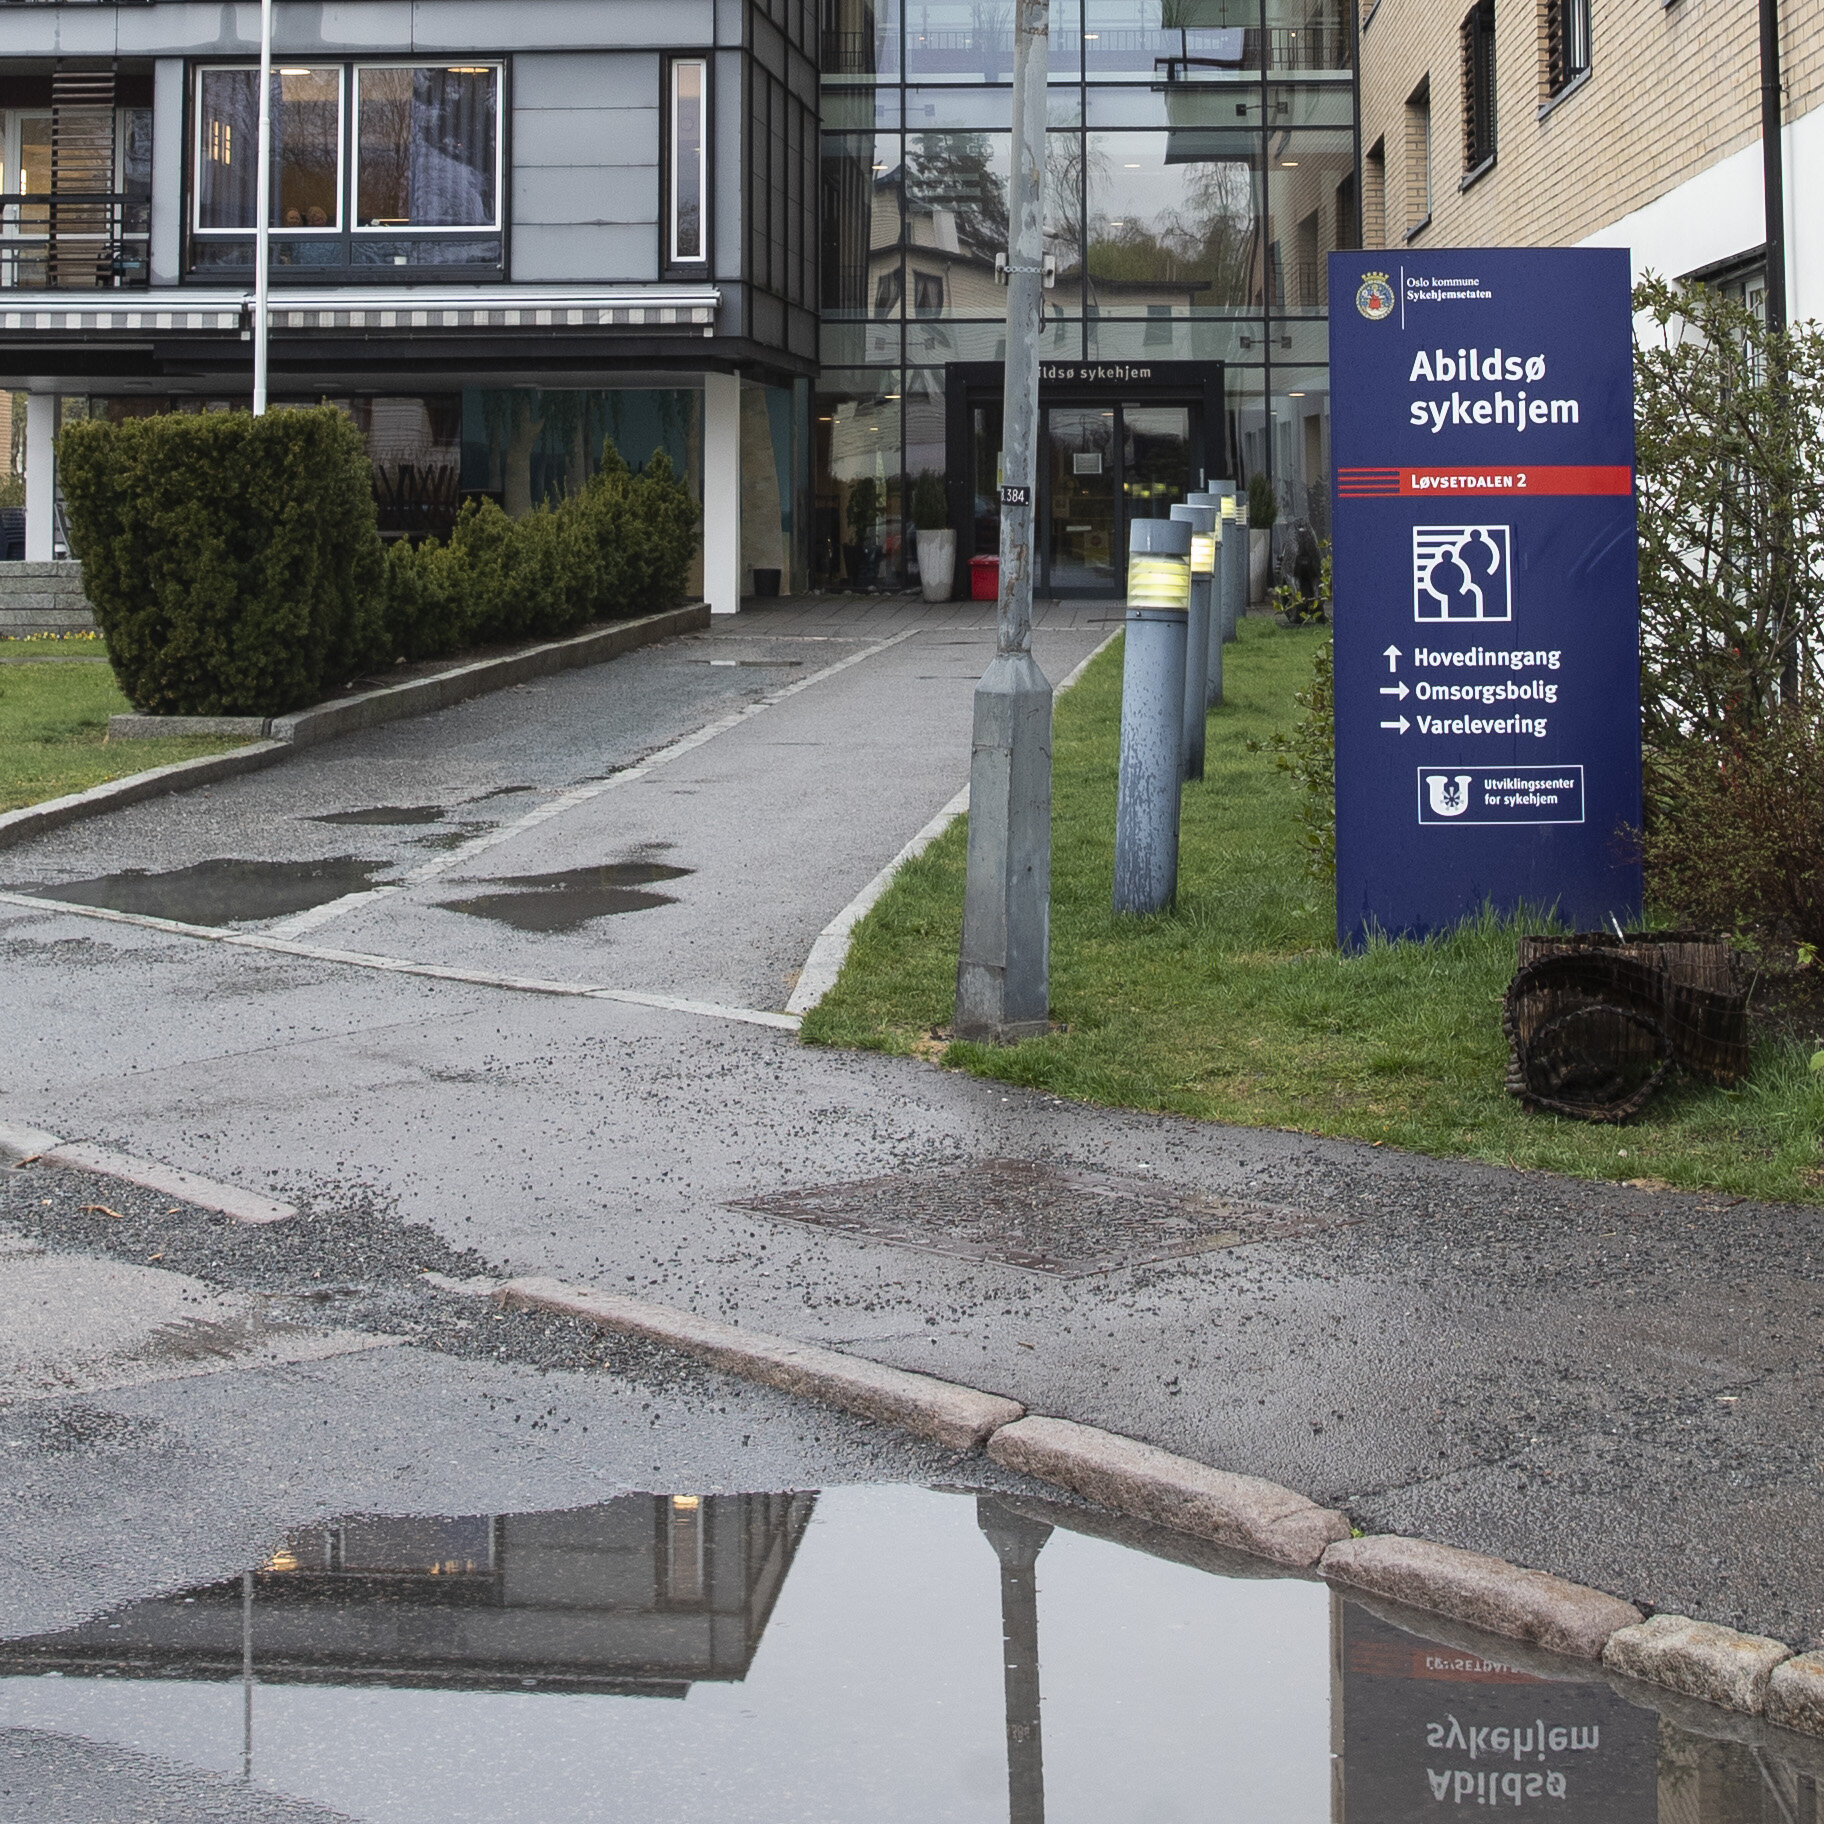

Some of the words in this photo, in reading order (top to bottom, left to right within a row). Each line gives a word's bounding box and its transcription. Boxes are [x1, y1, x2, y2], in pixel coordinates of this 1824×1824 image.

[1407, 278, 1429, 287] Oslo
[1432, 277, 1479, 287] kommune
[1407, 290, 1492, 301] Sykehjemsetaten
[1080, 366, 1151, 381] sykehjem
[1409, 348, 1546, 383] Abildsø
[1409, 391, 1579, 433] sykehjem
[1411, 474, 1513, 490] LØVSETDALEN
[1517, 473, 1527, 488] 2
[1414, 647, 1562, 670] Hovedinngang
[1415, 680, 1559, 704] Omsorgsbolig
[1416, 714, 1548, 737] Varelevering
[1484, 778, 1575, 791] Utviklingssenter
[1484, 793, 1501, 805] for
[1503, 793, 1558, 807] sykehjem
